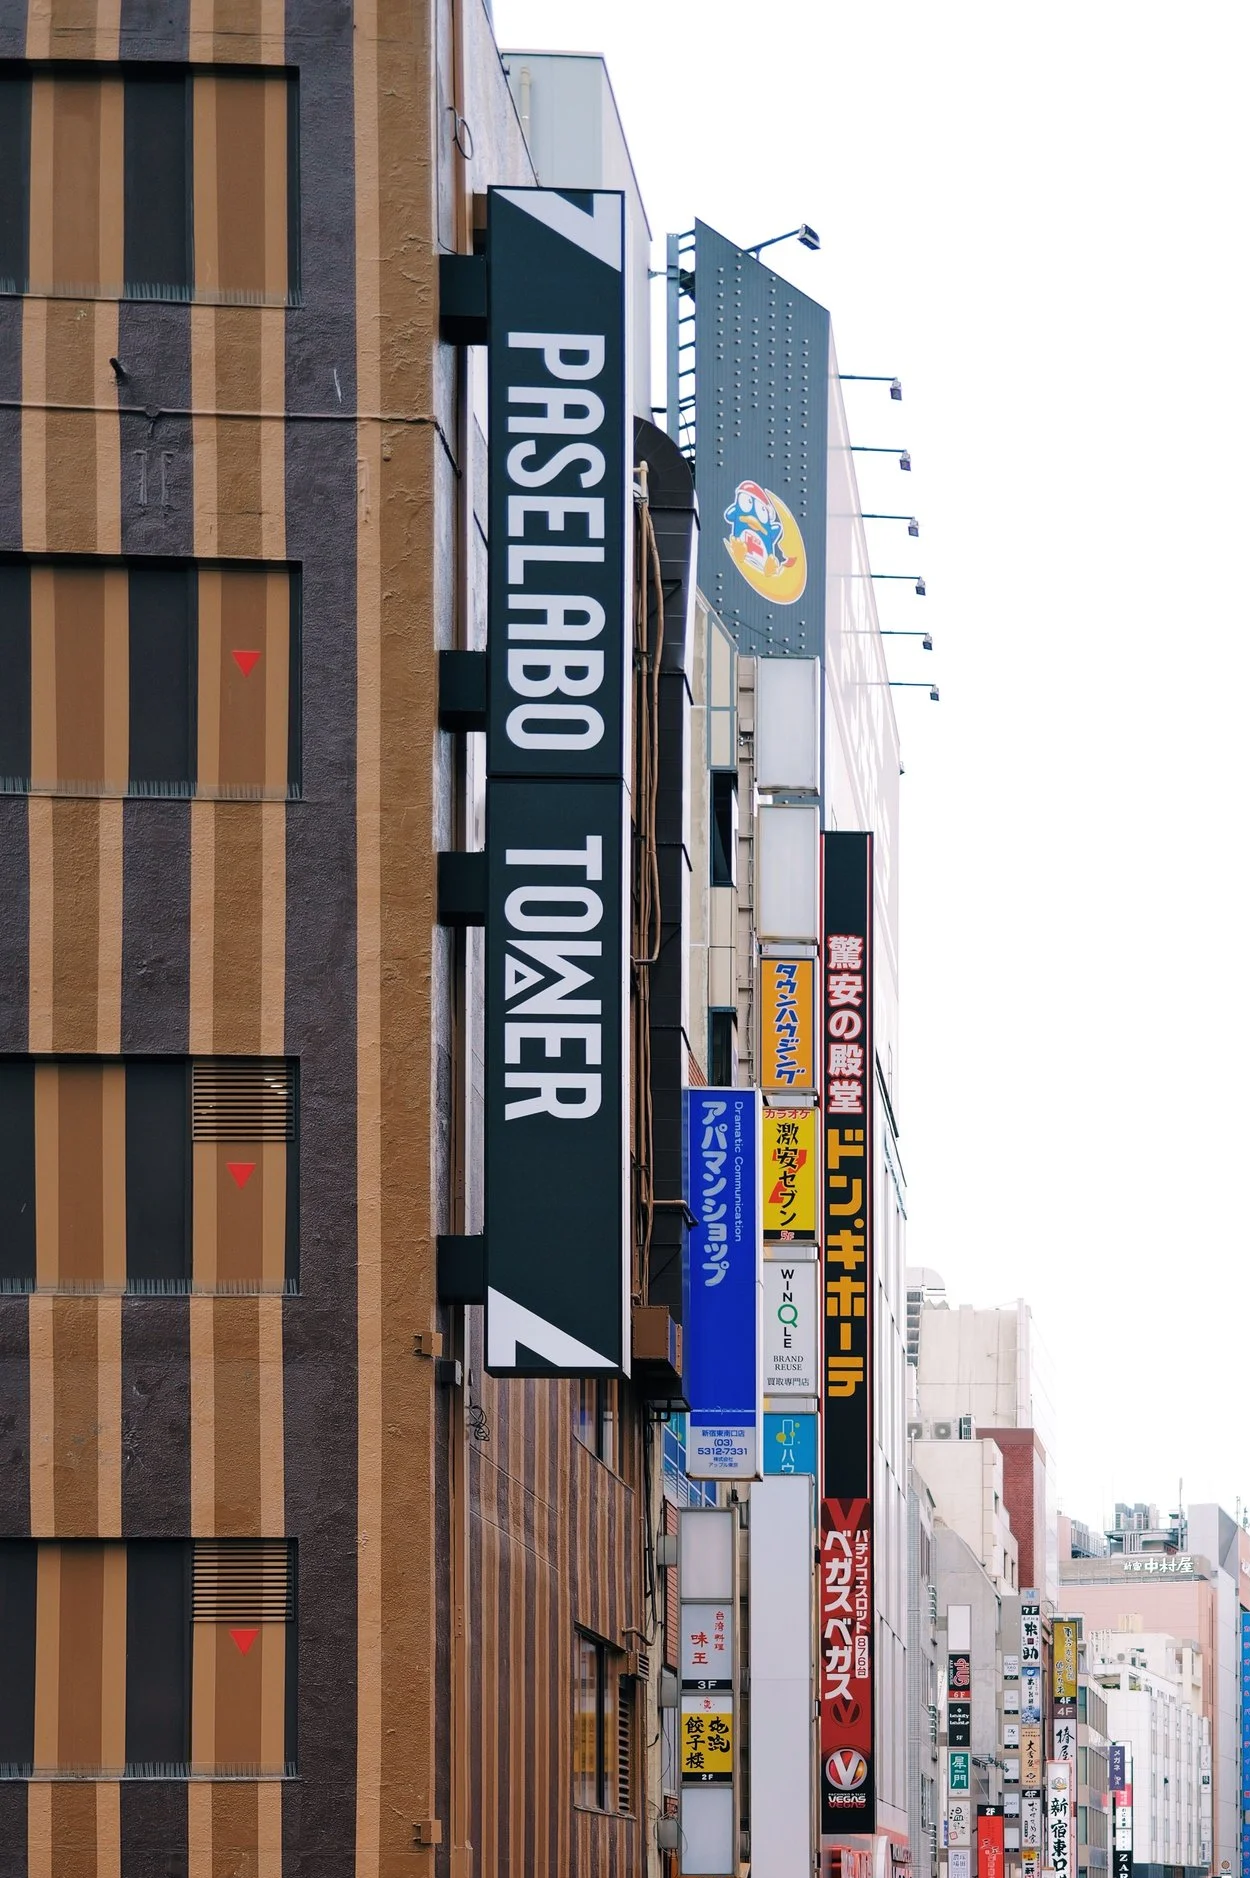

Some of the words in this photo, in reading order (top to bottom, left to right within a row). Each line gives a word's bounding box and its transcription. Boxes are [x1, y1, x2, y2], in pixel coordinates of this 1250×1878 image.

[506, 331, 606, 752] PASELABO
[504, 835, 604, 1121] TOWER
[774, 963, 806, 1085] タウンハウジング
[826, 935, 866, 1115] 驚安の殿堂
[733, 1101, 744, 1154] Dramatic
[765, 1108, 811, 1120] カラオケ
[775, 1122, 801, 1227] 激安セブン
[701, 1101, 728, 1286] アパマンショップ
[733, 1156, 744, 1243] Communication
[777, 1268, 799, 1349] WINQLE
[773, 1355, 804, 1364] BRAND
[774, 1364, 803, 1372] REUSE
[767, 1377, 809, 1386] 買取専門店
[701, 1429, 745, 1437] 新宿東南口店
[713, 1438, 733, 1447] (03)
[697, 1448, 748, 1456] 5312-7331
[855, 1529, 869, 1634] パチンコ・スロット
[824, 1529, 854, 1701] ベガスベガス
[1023, 1606, 1038, 1614] 7F
[690, 1632, 709, 1665] 味王
[714, 1611, 725, 1652] 台湾料理
[856, 1637, 868, 1677] 876台
[697, 1680, 717, 1690] 3F
[1059, 1696, 1072, 1704] 4F
[1057, 1707, 1073, 1716] 4F
[1056, 1726, 1075, 1761] 椿屋
[985, 1807, 996, 1815] 2F
